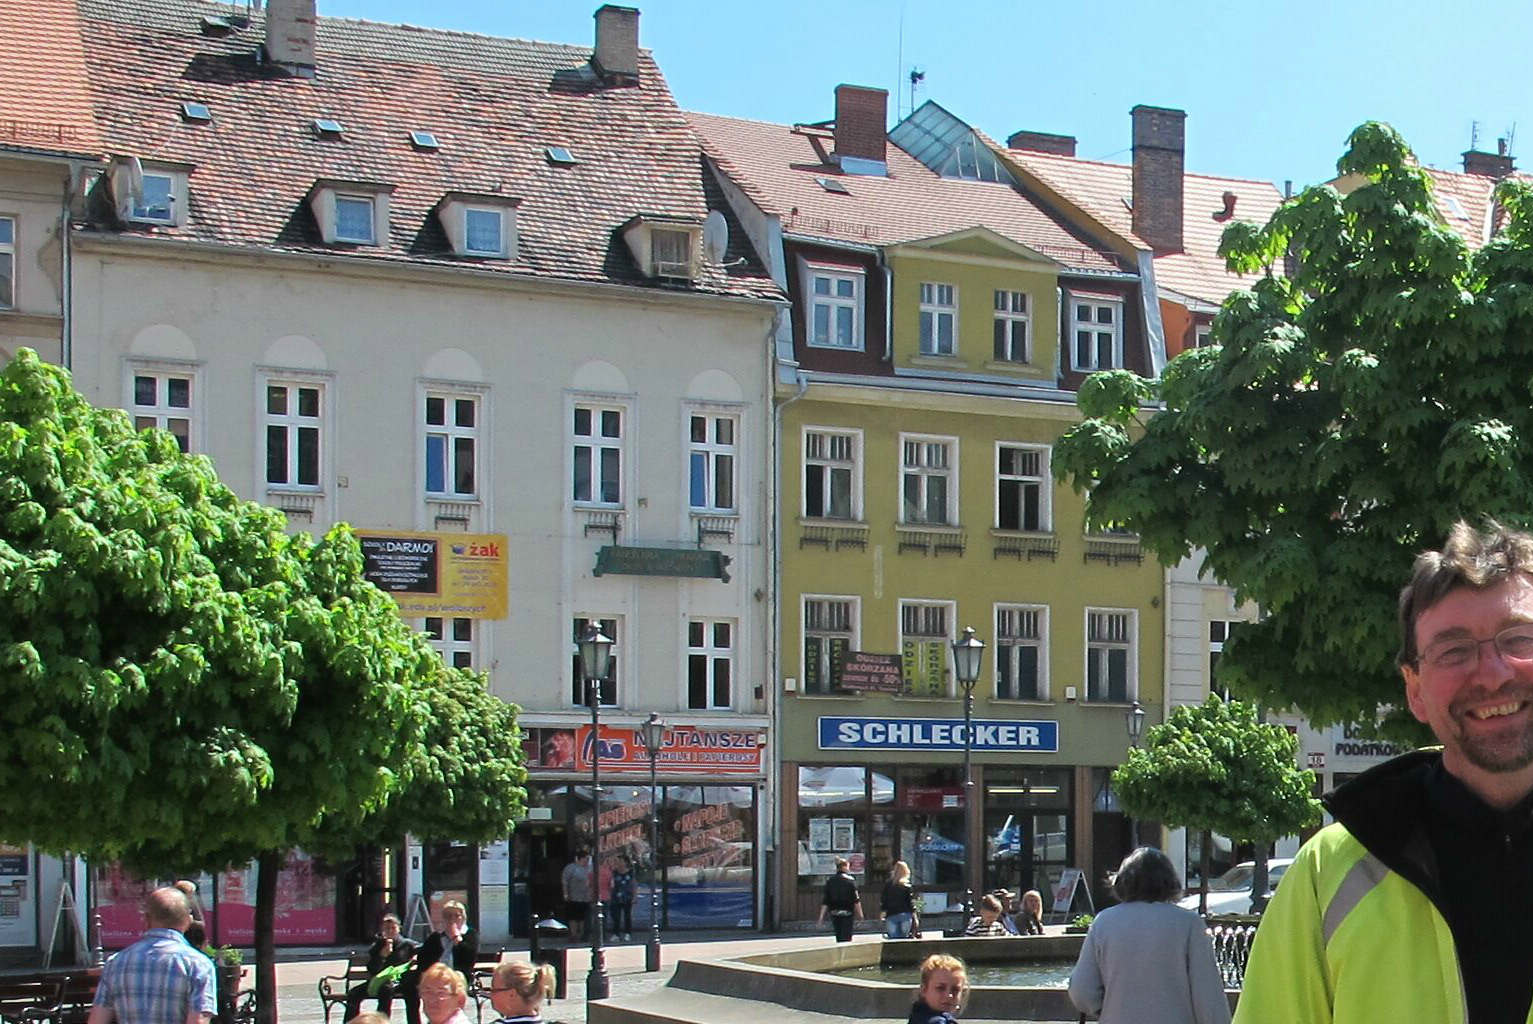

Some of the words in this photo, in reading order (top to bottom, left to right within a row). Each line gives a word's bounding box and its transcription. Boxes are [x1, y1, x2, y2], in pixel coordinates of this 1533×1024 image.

[470, 542, 499, 557] żak
[838, 722, 1041, 746] SCHLECKER
[633, 751, 692, 761] ALOHOLE
